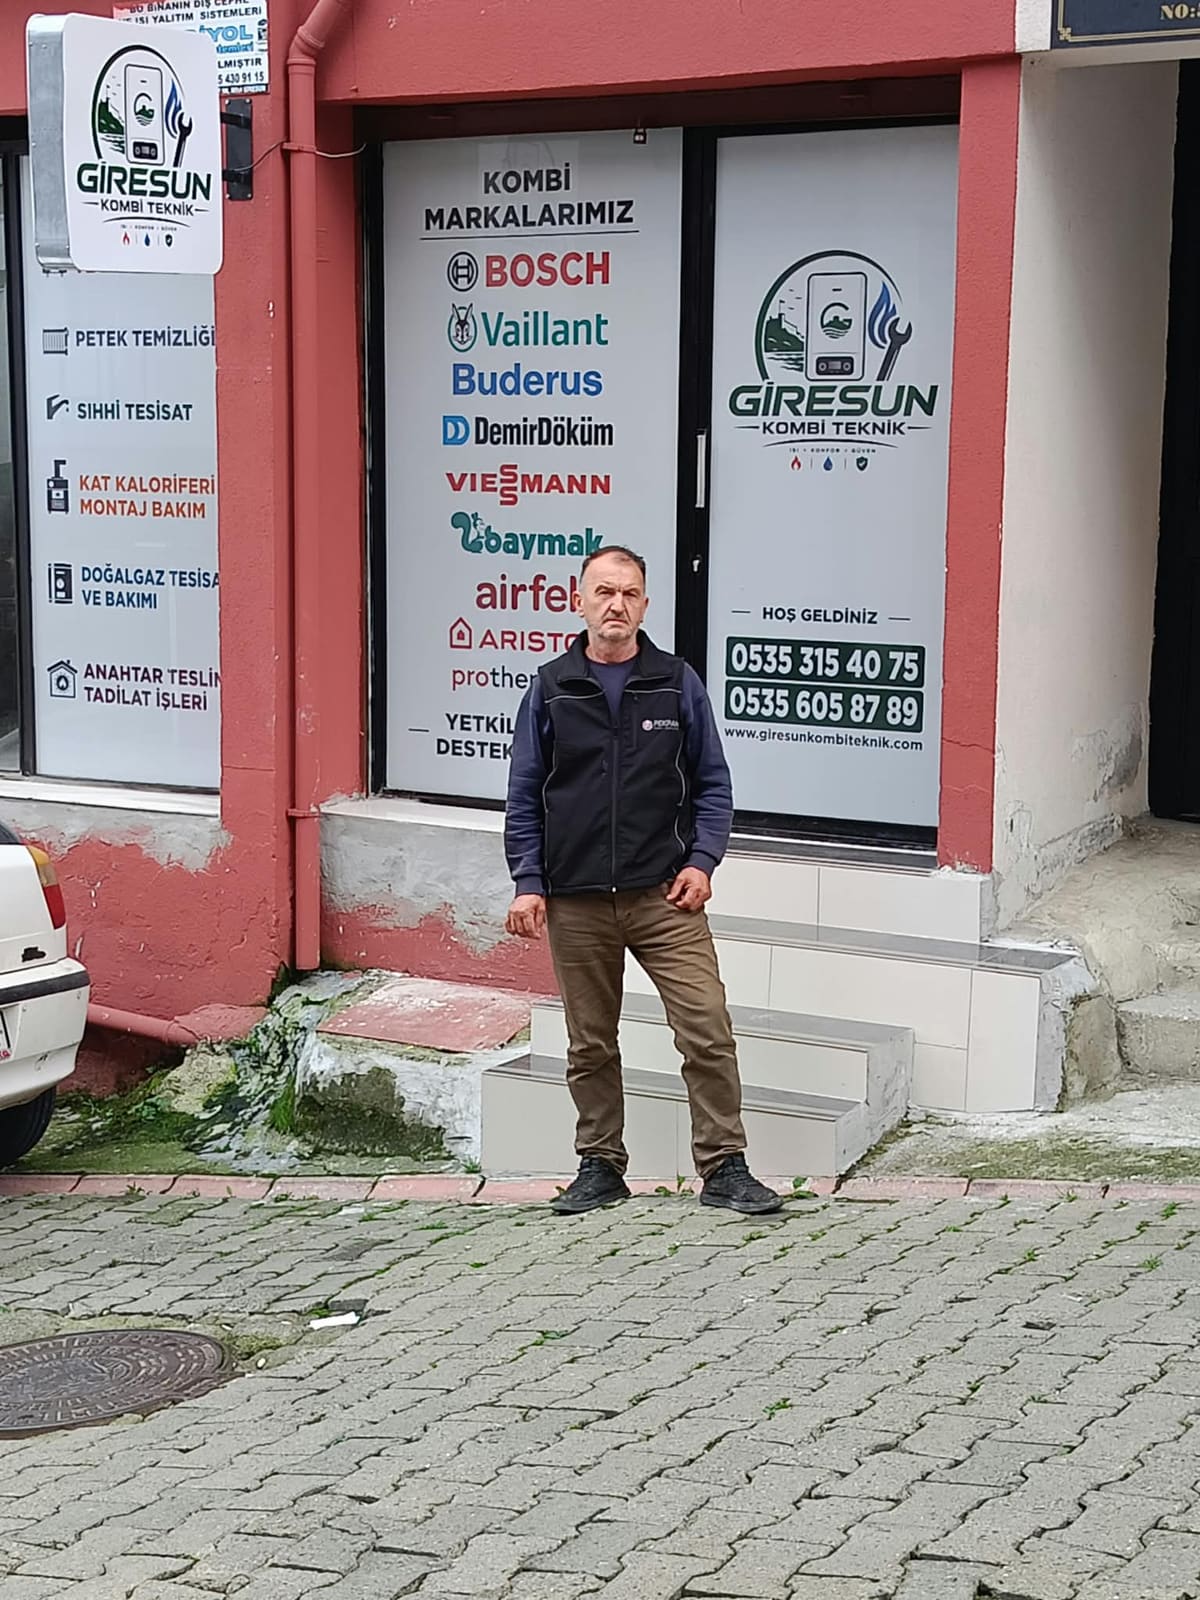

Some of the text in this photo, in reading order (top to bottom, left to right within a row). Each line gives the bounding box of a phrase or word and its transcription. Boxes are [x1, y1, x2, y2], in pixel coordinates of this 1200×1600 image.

[152, 13, 194, 24] YALITIM
[200, 6, 262, 20] SİSTEMLERİ
[194, 0, 211, 8] DIŞ
[242, 73, 251, 82] 91
[255, 72, 264, 82] 15
[76, 161, 212, 200] GİRESUN
[484, 162, 570, 194] KOMBİ
[100, 198, 194, 216] KOMBİ TEKNİK
[424, 200, 634, 230] MARKALARIMIZ
[486, 252, 610, 288] BOSCH
[76, 325, 215, 347] PETEK TEMİZLİĞİ
[481, 311, 608, 346] Vaillant
[452, 363, 603, 396] Buderus
[728, 381, 938, 416] GİRESUN
[77, 400, 193, 421] SIHHİ TESİSAT
[475, 416, 614, 446] DemirDöküm
[762, 419, 906, 435] KOMBİ TEKNİK
[80, 474, 216, 494] KAT KALORİFERİ
[446, 464, 610, 506] VIESSMANN
[80, 499, 206, 519] MONTAJ BAKIM
[484, 528, 603, 560] baymak
[82, 563, 165, 586] DOĞALGAZ
[82, 590, 157, 609] VE BAKIMI
[476, 574, 578, 612] airfel
[762, 607, 878, 624] HOŞ GELDİNİZ
[84, 664, 163, 684] ANAHTAR
[731, 643, 919, 682] 0535 315 40 75
[84, 684, 208, 711] TADİLAT İŞLERİ
[730, 686, 918, 726] 0535 605 87 89
[445, 712, 514, 734] YETKİL
[436, 738, 512, 760] DESTEK
[724, 727, 923, 751] www.giresunkombiteknik.com
